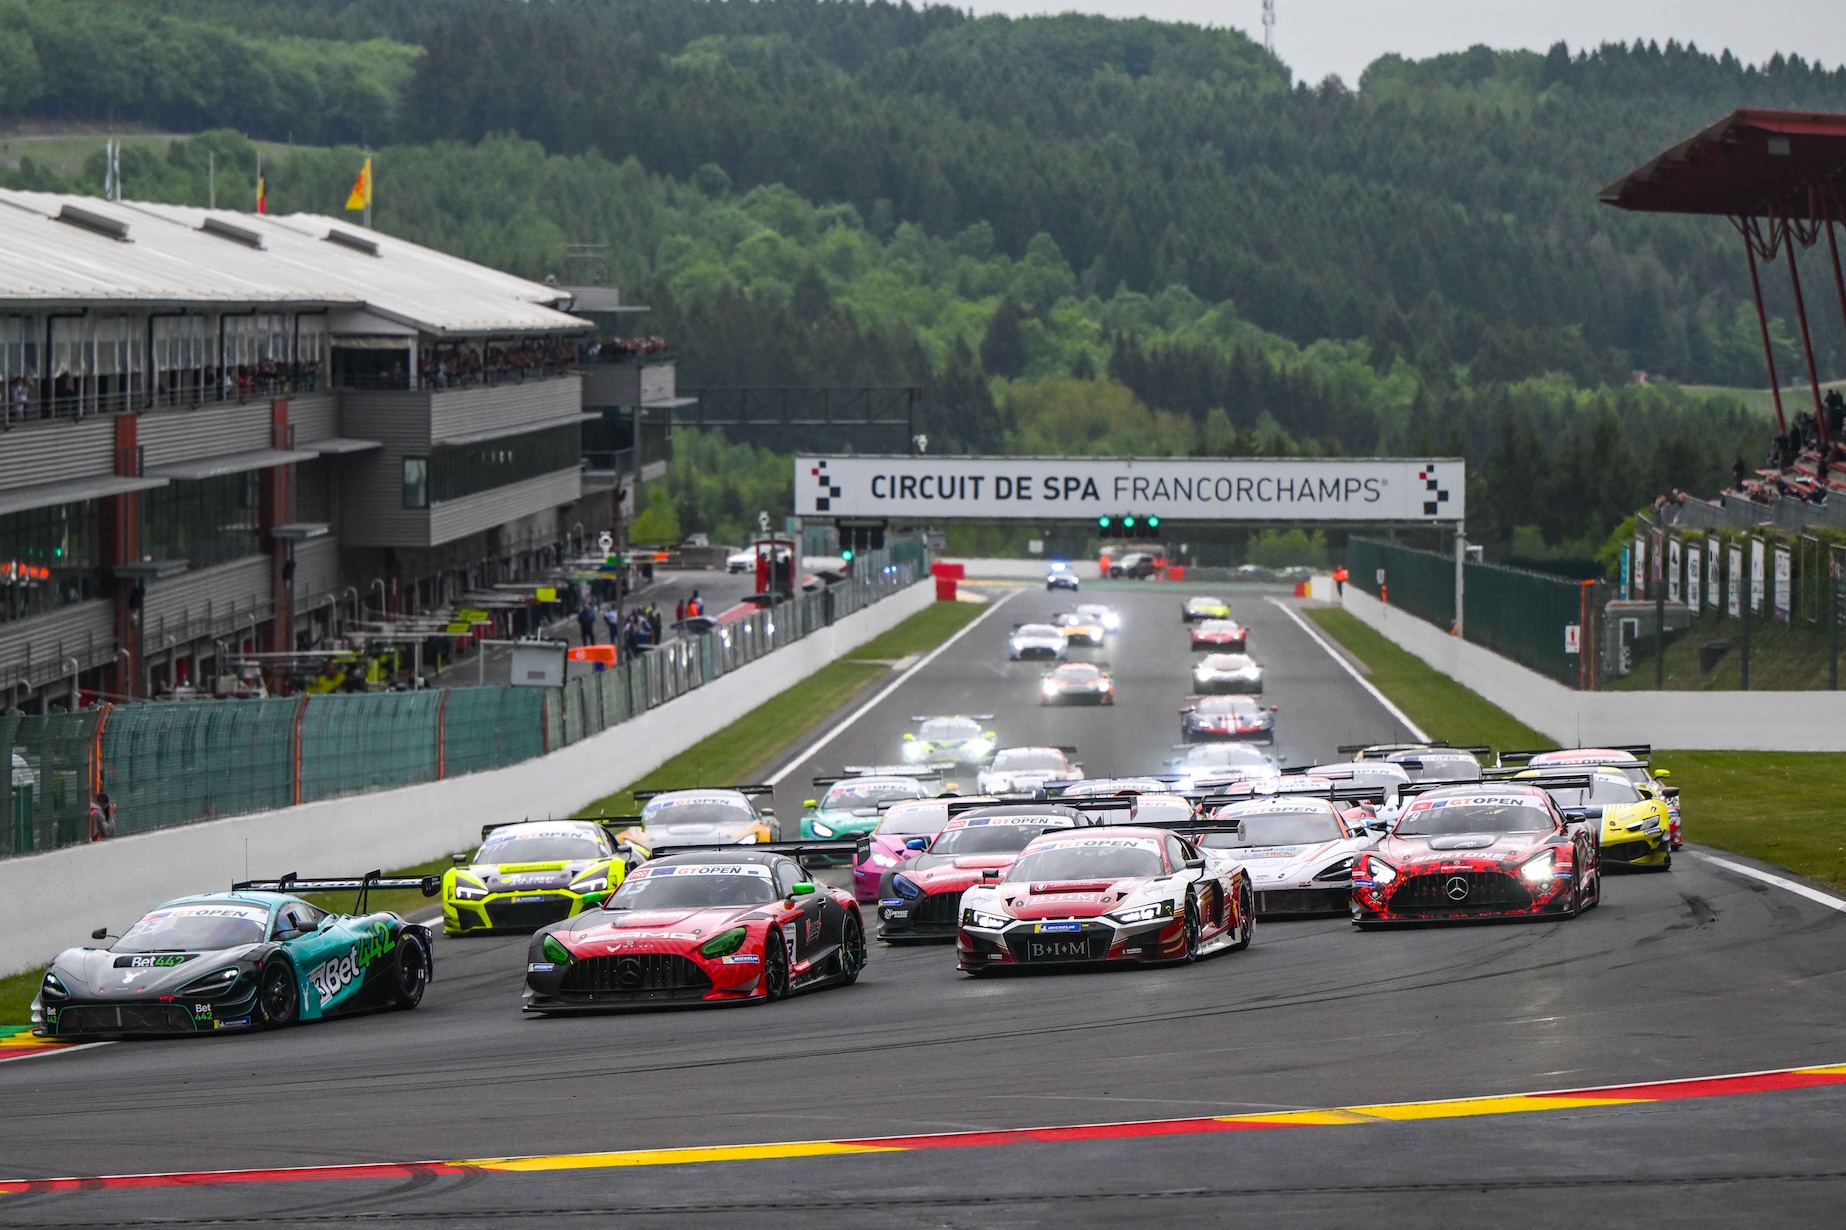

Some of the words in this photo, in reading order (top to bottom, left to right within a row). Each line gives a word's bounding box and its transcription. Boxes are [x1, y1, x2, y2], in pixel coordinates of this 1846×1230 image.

[870, 474, 985, 501] CIRCUIT
[994, 475, 1033, 501] DE
[1042, 475, 1101, 502] SPA
[630, 870, 648, 879] PRO
[131, 955, 185, 968] Bet442
[324, 921, 396, 996] Bet442
[195, 1003, 212, 1013] Bet
[195, 1012, 213, 1022] 442
